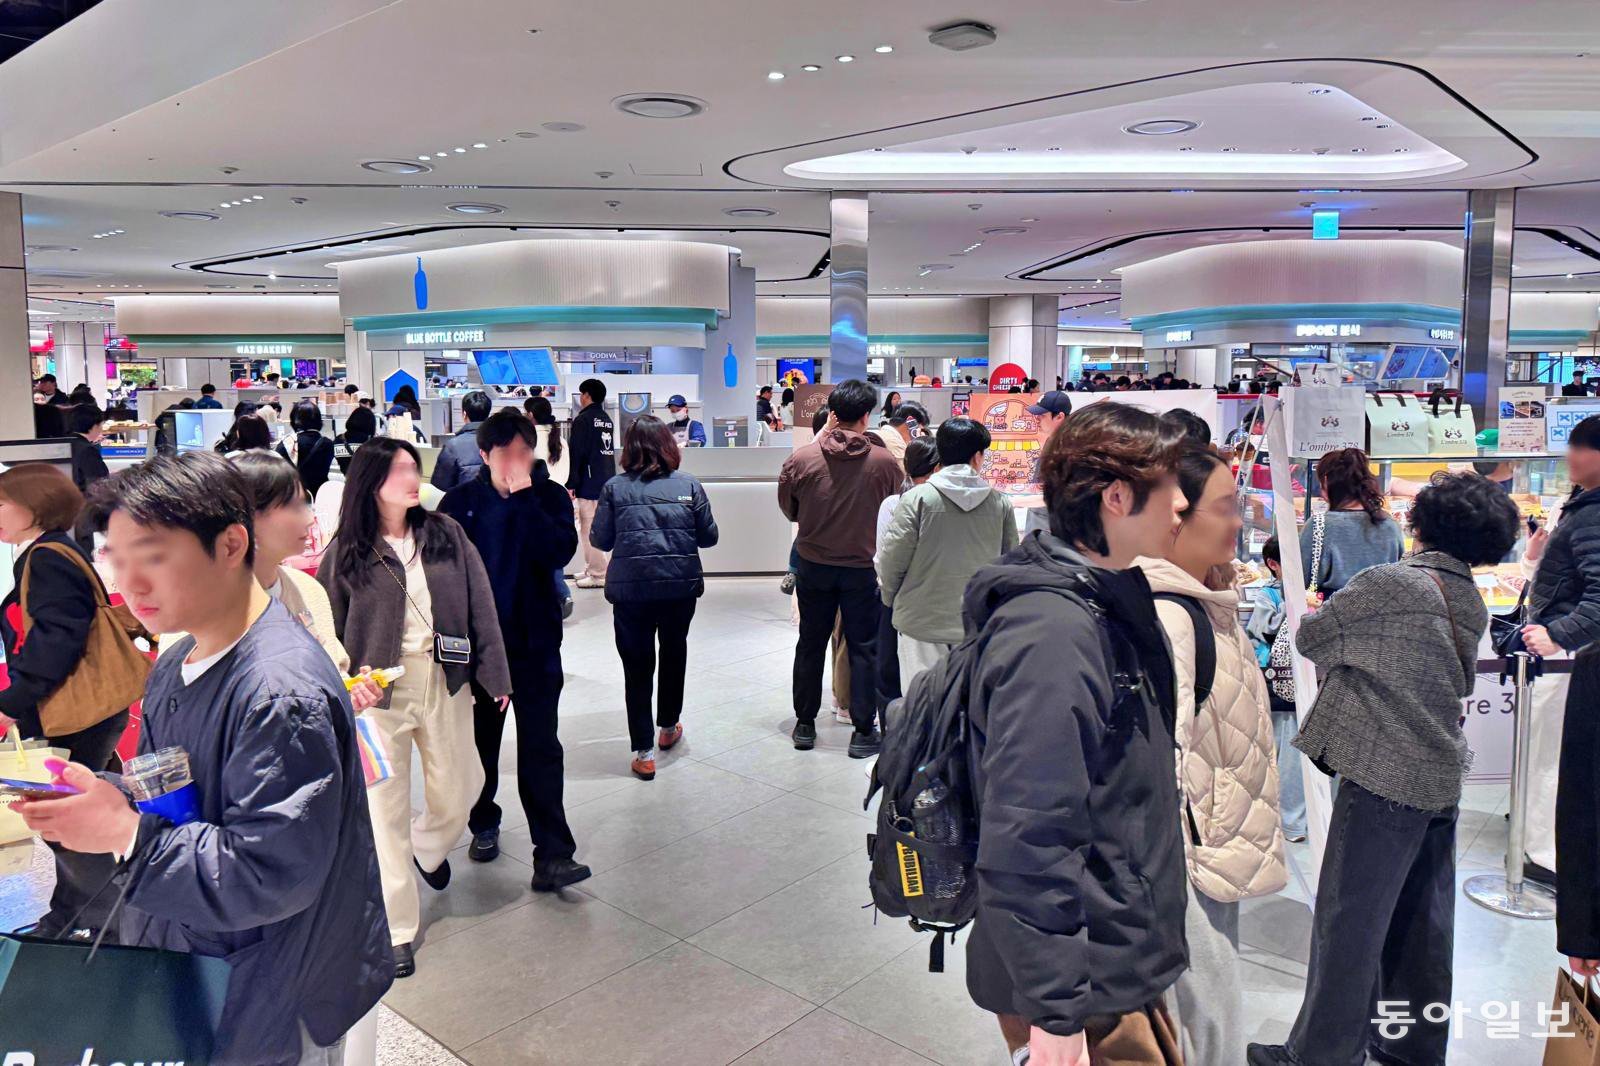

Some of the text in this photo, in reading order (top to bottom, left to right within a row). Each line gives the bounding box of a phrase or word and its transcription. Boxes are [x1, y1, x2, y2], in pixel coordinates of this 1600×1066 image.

[406, 330, 484, 344] BLUE BOTTLE COFFEE
[999, 377, 1018, 385] DIRTY
[1300, 442, 1339, 452] L'ombre
